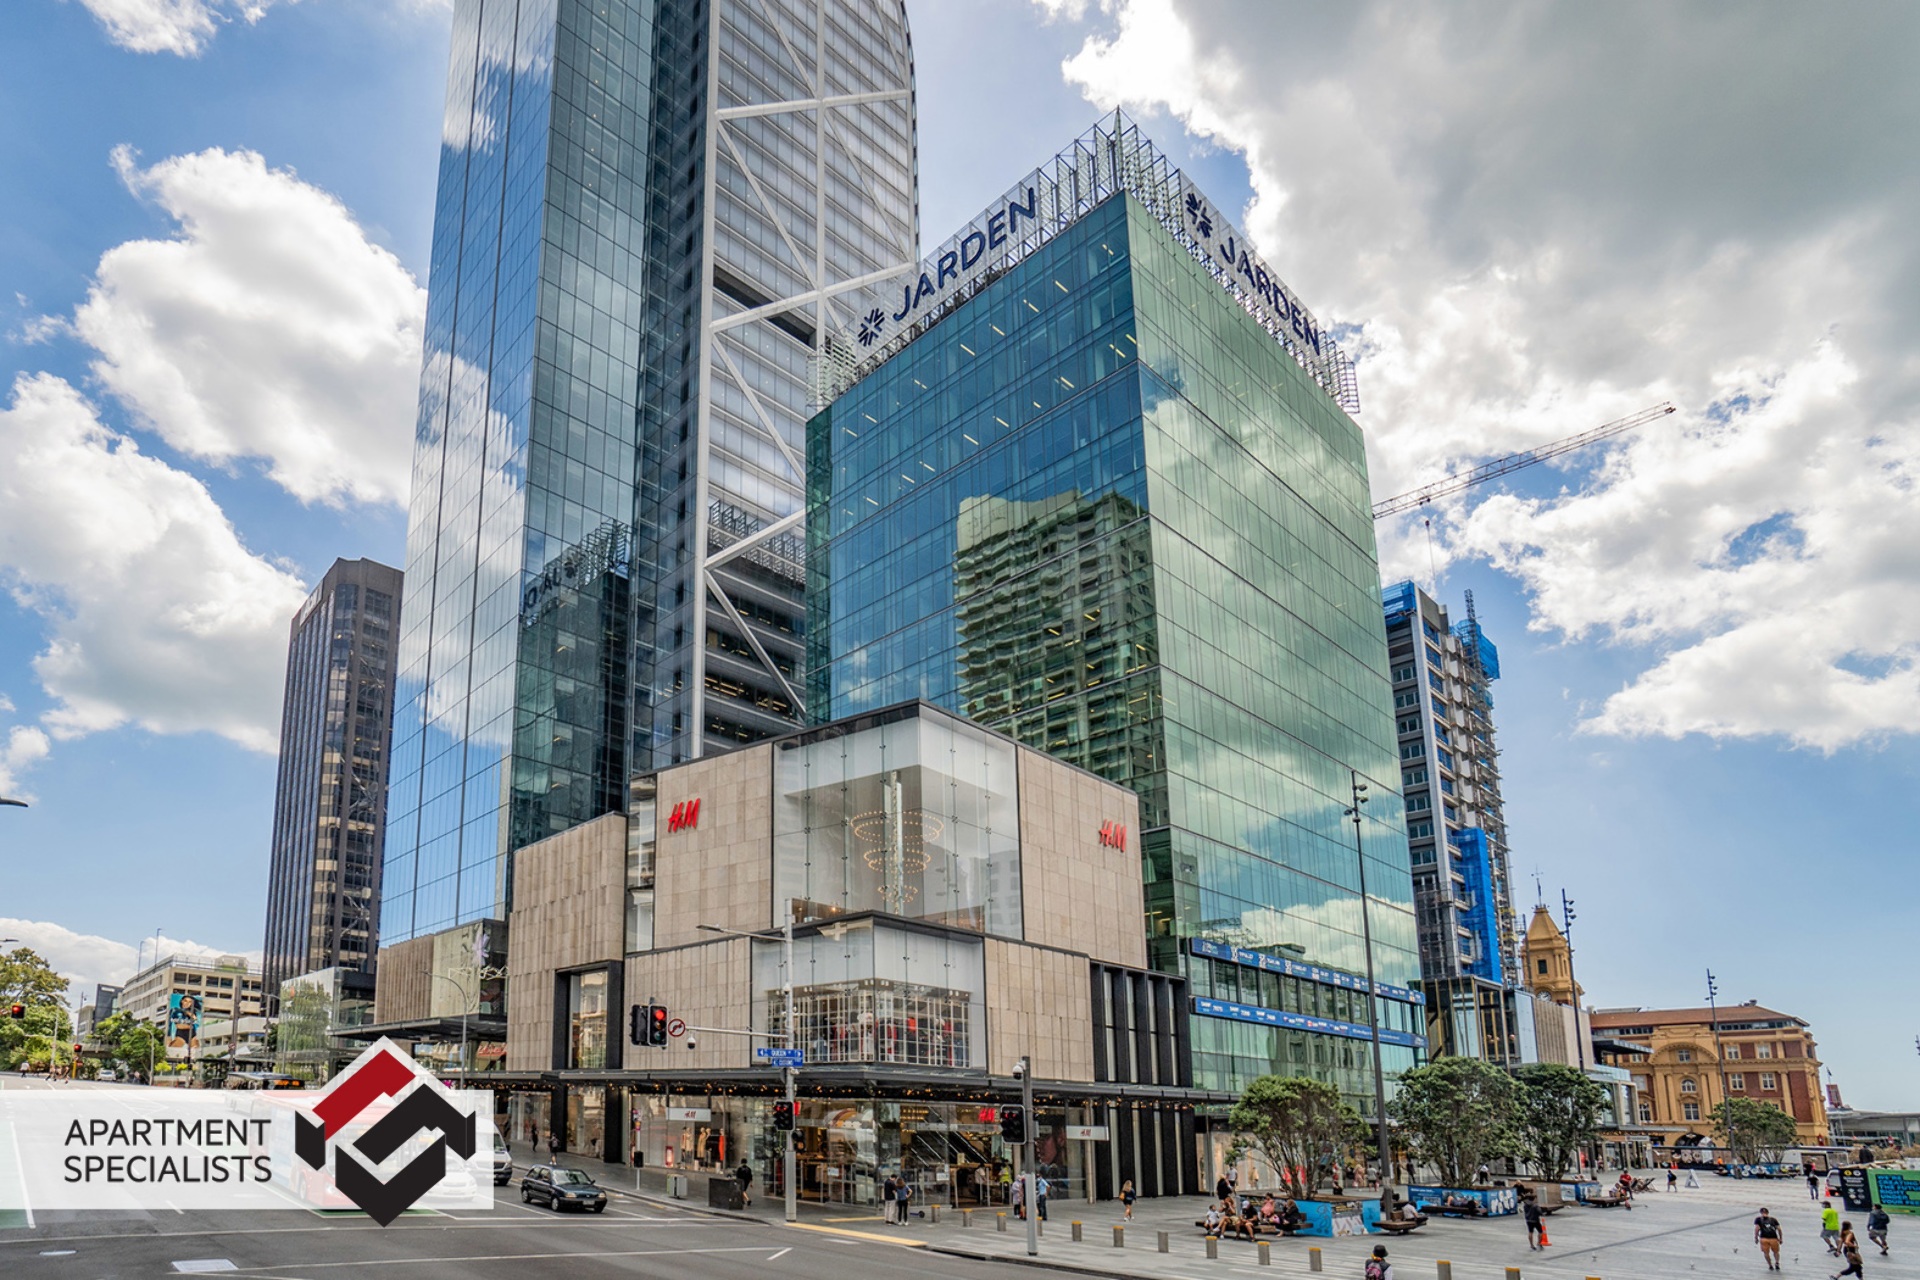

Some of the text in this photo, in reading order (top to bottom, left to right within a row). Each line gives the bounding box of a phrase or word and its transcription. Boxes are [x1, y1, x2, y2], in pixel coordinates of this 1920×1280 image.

[893, 187, 1036, 321] JARDEN
[1219, 236, 1321, 356] JARDEN
[668, 798, 700, 832] H&M
[1098, 819, 1127, 853] H&M
[685, 1111, 696, 1119] H&M
[978, 1108, 995, 1122] H&M
[1081, 1129, 1091, 1137] H&M
